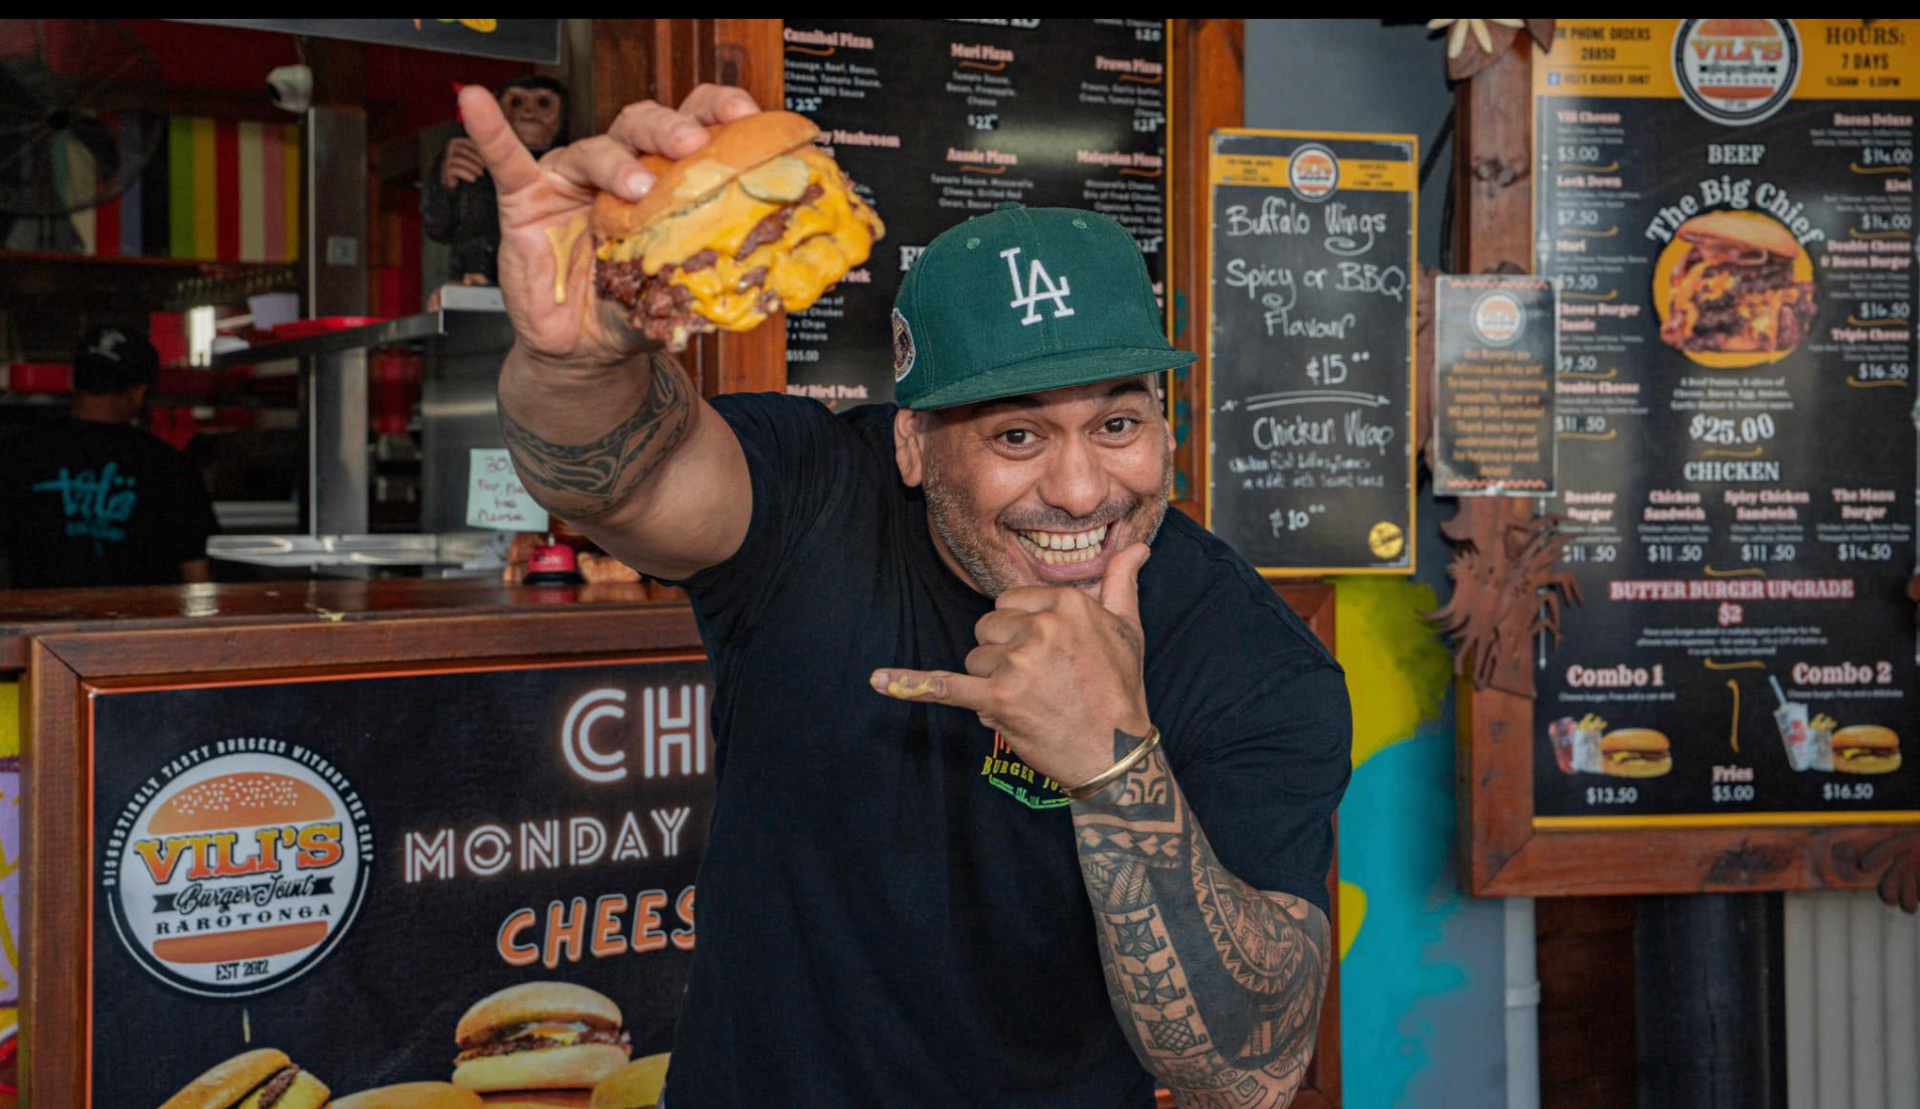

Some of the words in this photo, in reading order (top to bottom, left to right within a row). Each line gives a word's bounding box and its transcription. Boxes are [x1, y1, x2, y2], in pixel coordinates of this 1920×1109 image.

[839, 32, 874, 50] Pizza
[1570, 27, 1605, 41] PHONE
[1825, 26, 1906, 46] HOURS:
[982, 45, 1014, 63] Pizza
[1841, 52, 1849, 70] 7
[1853, 52, 1890, 70] DAYS
[985, 149, 1019, 165] Pizza
[1707, 144, 1766, 165] BEEF
[1644, 194, 1700, 243] The
[1698, 174, 1752, 209] Big
[1755, 182, 1825, 246] Chief
[1225, 195, 1311, 237] Buffalo
[1324, 202, 1387, 256] Wings
[1000, 247, 1075, 326] LA
[1225, 258, 1297, 310] Spicy
[1303, 269, 1329, 290] or
[1335, 261, 1407, 303] BBQ
[1263, 308, 1356, 340] Flavour
[1252, 415, 1336, 450] Chicken
[1344, 409, 1395, 455] Wrap
[1689, 412, 1776, 445] $25.00
[1683, 461, 1781, 482] CHICKEN
[1609, 580, 1687, 601] BUTTER
[1688, 579, 1766, 600] BURGER
[1766, 578, 1855, 600] UPGRADE
[1717, 601, 1744, 627] $2
[1565, 664, 1649, 688] Combo
[1651, 663, 1665, 687] 1
[1791, 660, 1874, 685] Combo
[1875, 660, 1893, 685] 2
[980, 755, 1036, 785] BURGER
[1712, 764, 1754, 783] Fries
[160, 744, 211, 779] TASTY
[216, 737, 287, 754] BURGERS
[344, 791, 368, 822] THE
[356, 822, 375, 863] CRAP
[1586, 787, 1638, 804] $13.50
[1712, 784, 1755, 802] $5.00
[1822, 782, 1874, 800] $16.50
[133, 821, 345, 886] VILI'S
[405, 806, 692, 885] MONDAY
[174, 883, 254, 916] Burger
[253, 873, 314, 907] Joint
[155, 903, 332, 936] RAROTONGA
[496, 885, 696, 970] CHEES
[215, 962, 240, 981] EST
